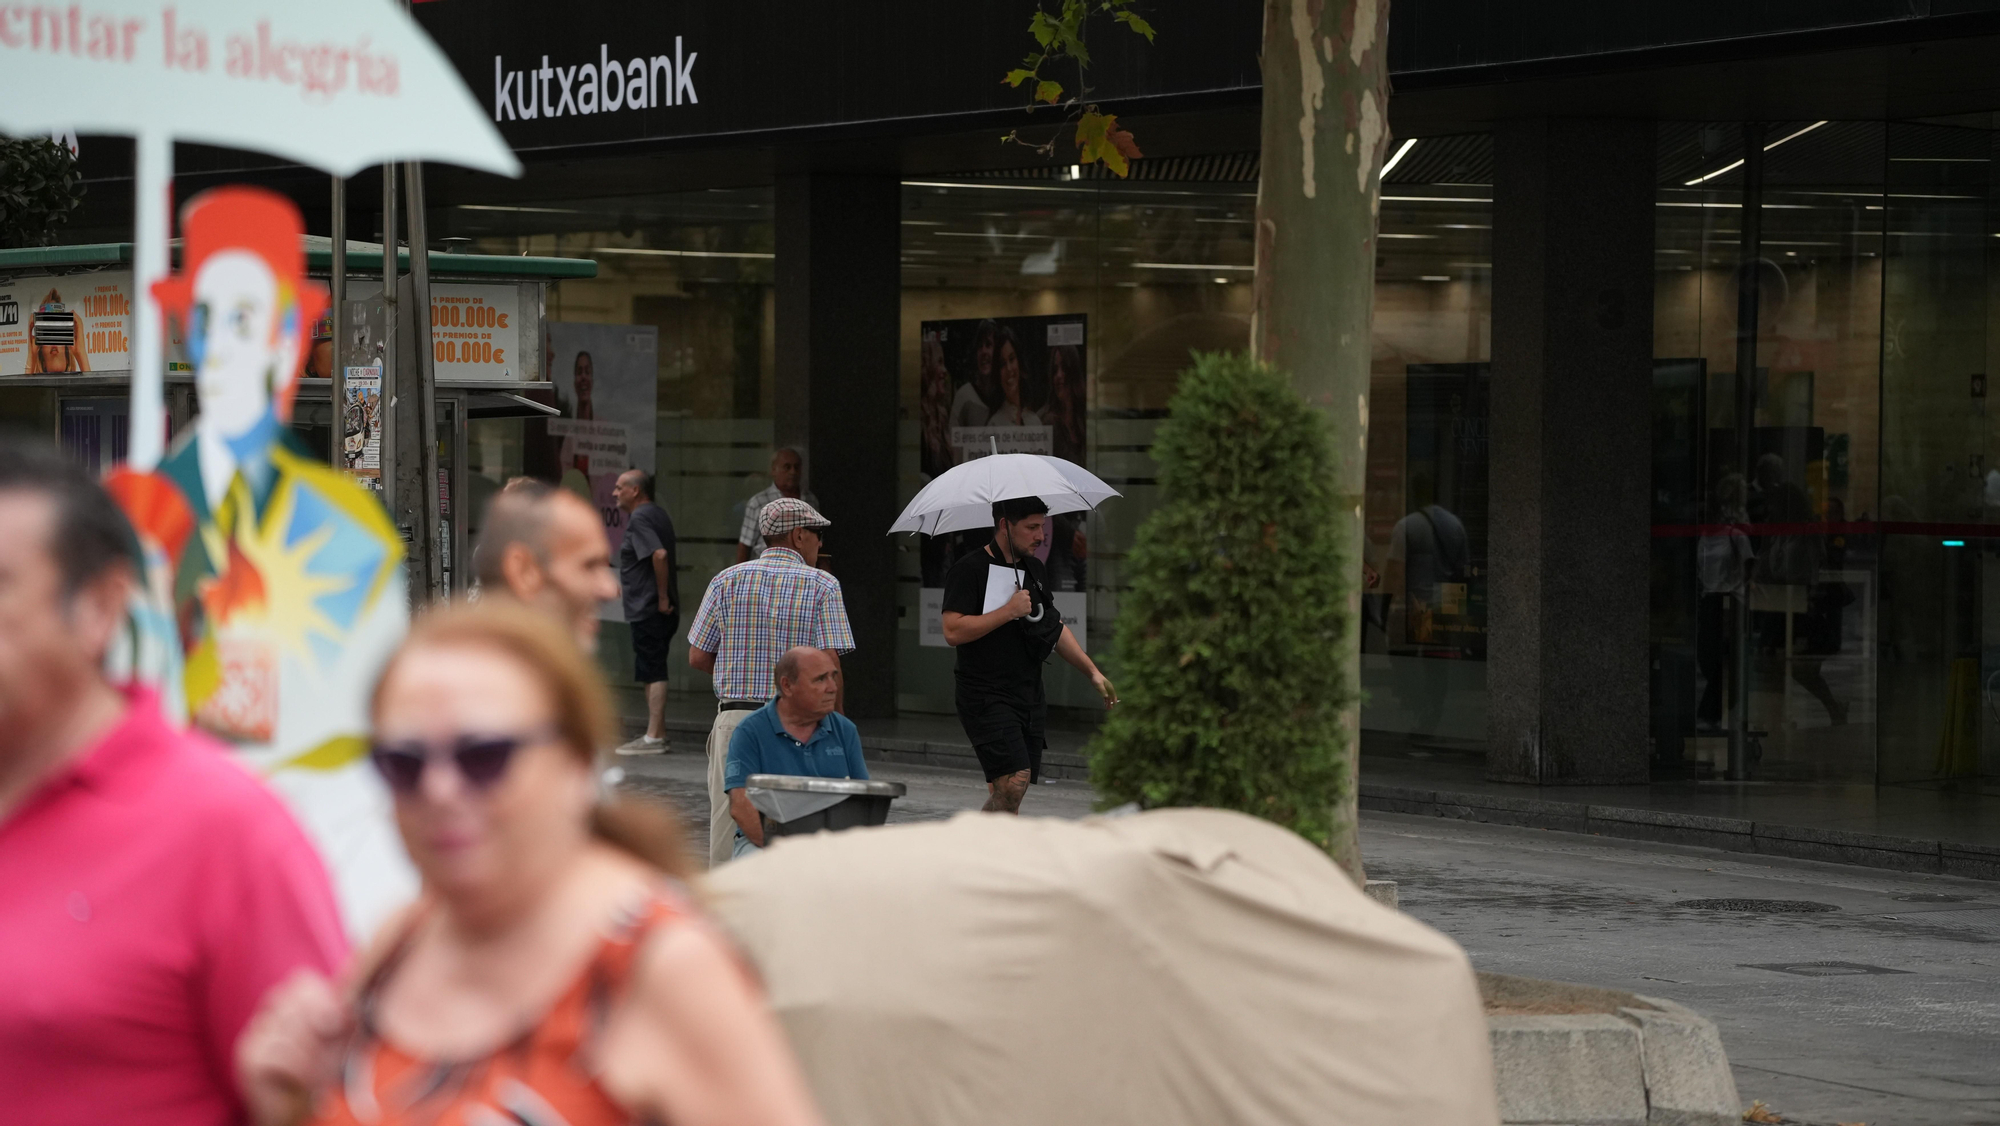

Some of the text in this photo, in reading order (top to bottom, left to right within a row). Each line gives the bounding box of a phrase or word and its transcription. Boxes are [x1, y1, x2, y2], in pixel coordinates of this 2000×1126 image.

[162, 6, 209, 71] la
[225, 20, 400, 106] alegría
[495, 35, 698, 122] kutxabank
[84, 293, 130, 318] 11.000.000€
[439, 296, 471, 304] PREMIO
[86, 330, 129, 354] 1.000.000€
[433, 340, 505, 364] 00.000€
[977, 431, 1000, 443] cliete
